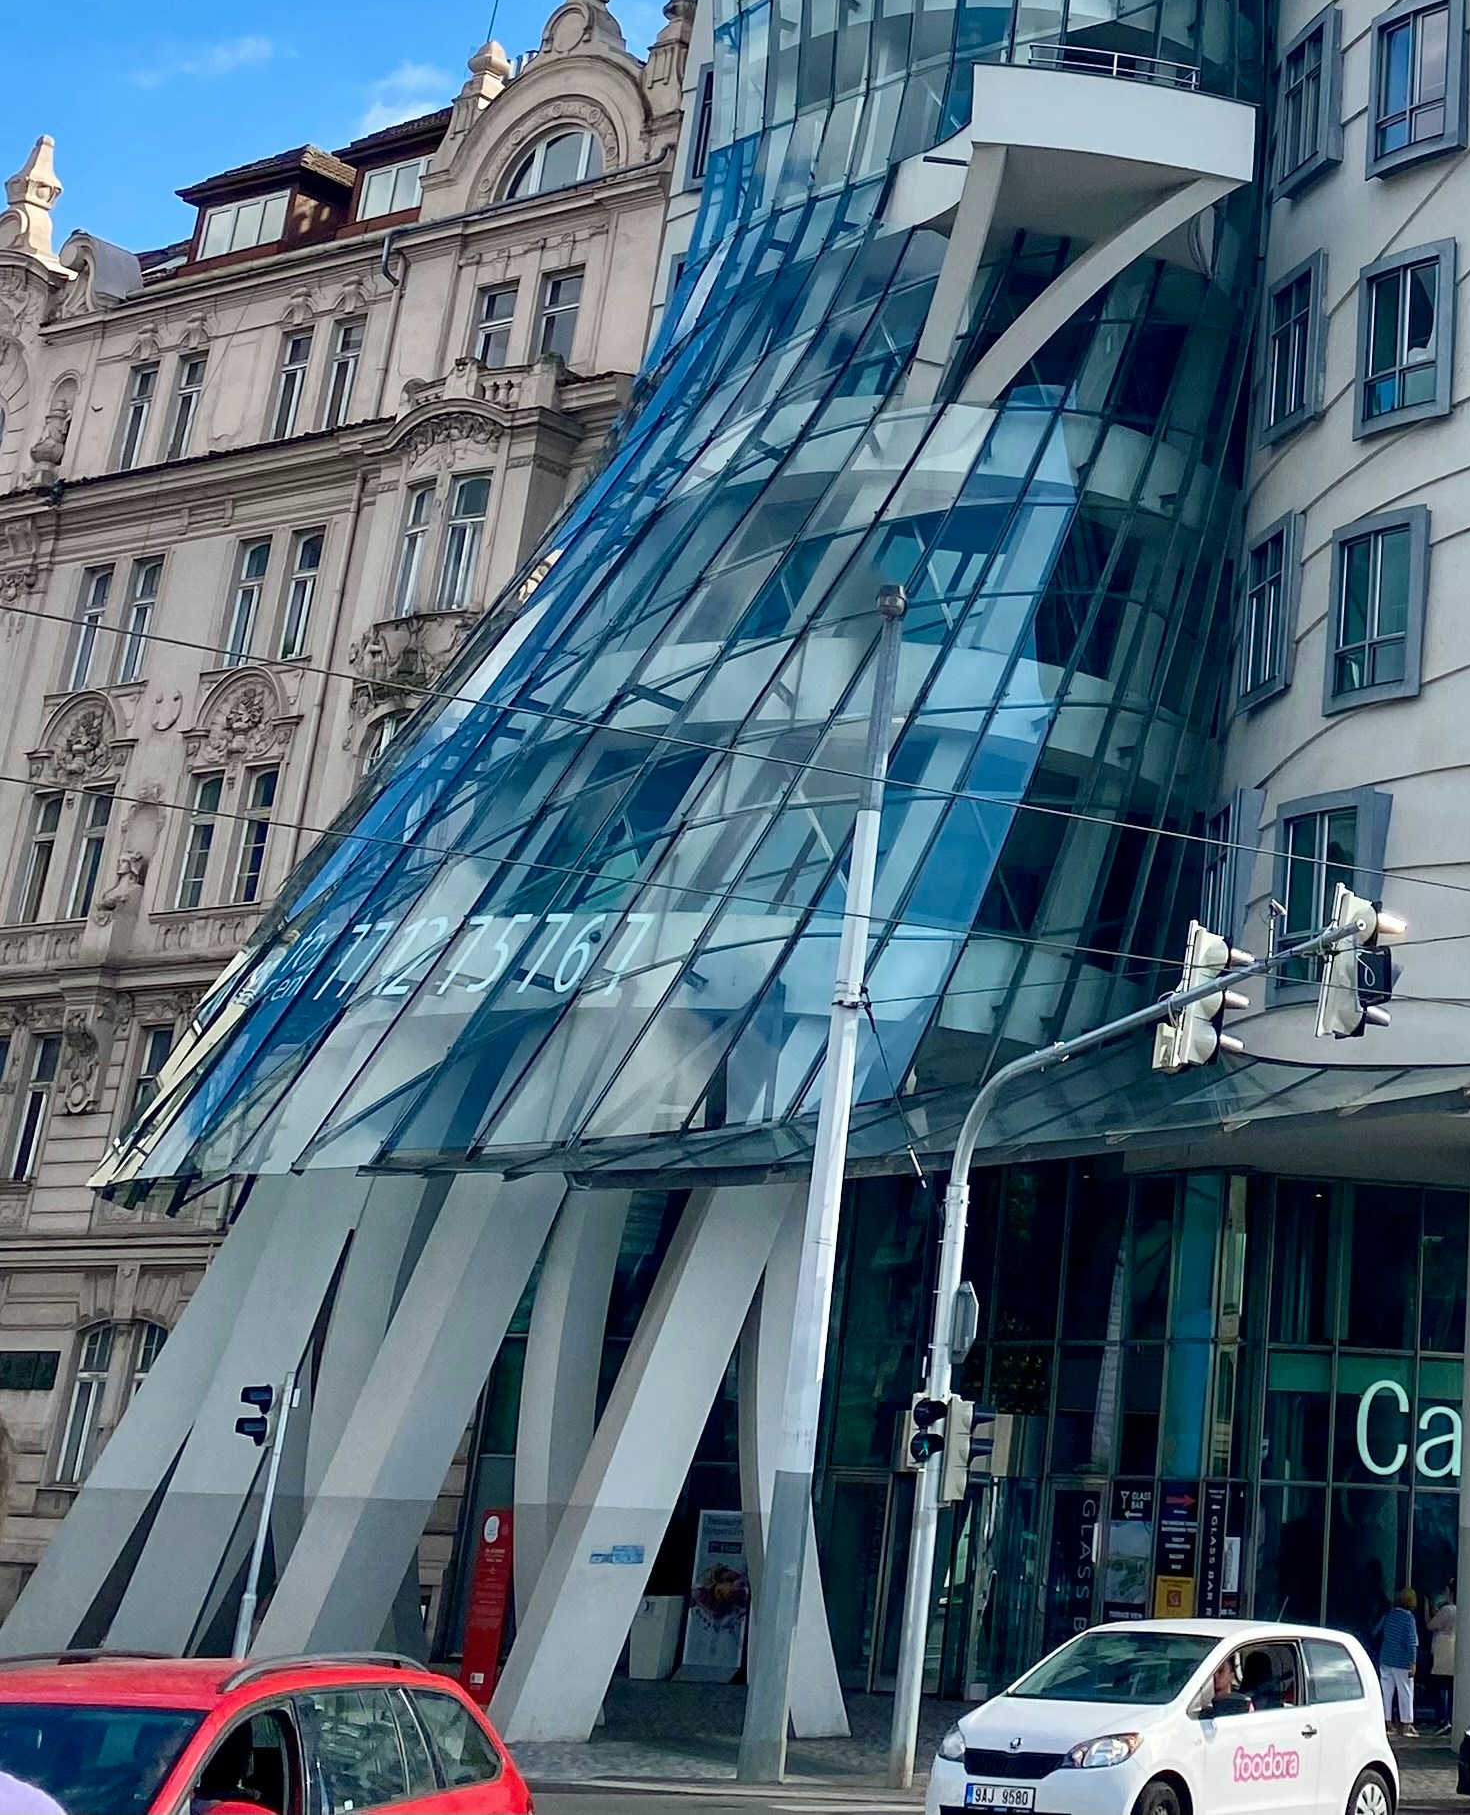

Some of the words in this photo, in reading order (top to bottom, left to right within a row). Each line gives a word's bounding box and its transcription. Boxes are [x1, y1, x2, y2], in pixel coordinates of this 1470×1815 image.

[1076, 1499, 1097, 1599] GLASS
[1208, 1515, 1219, 1564] GLASS
[1206, 1571, 1215, 1601] BAR
[1233, 1744, 1299, 1782] foodora
[974, 1788, 996, 1804] 9AJ
